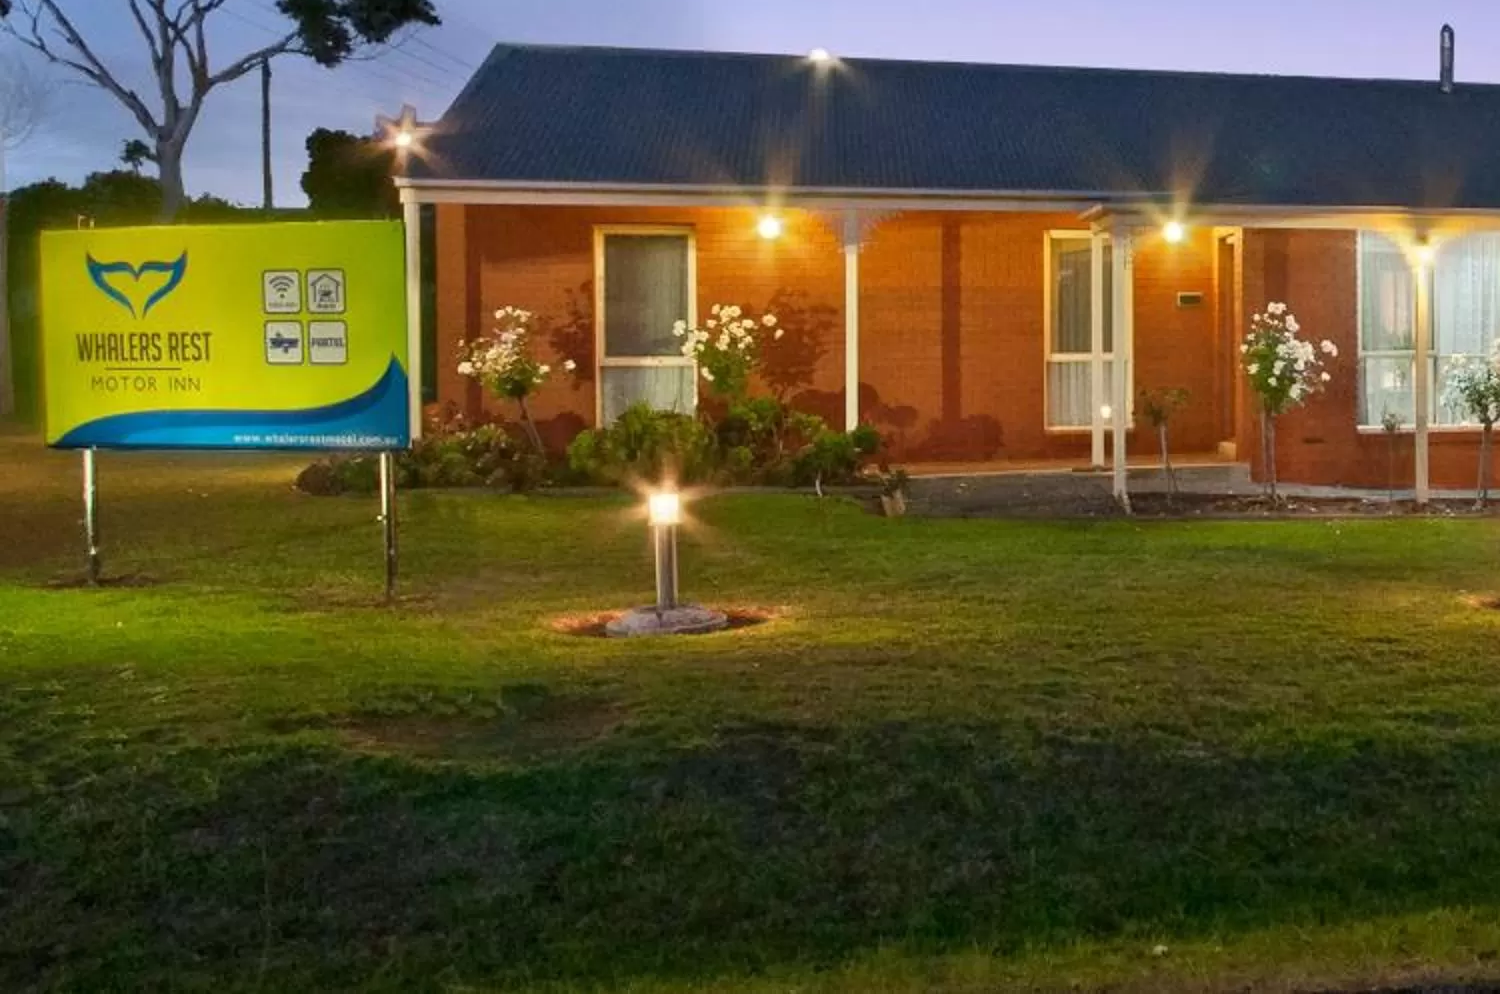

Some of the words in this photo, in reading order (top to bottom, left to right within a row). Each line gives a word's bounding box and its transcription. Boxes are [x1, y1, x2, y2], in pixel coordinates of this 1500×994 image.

[76, 333, 162, 362] WHALERS
[168, 332, 212, 362] REST
[91, 375, 158, 392] MOTOR
[168, 375, 201, 391] INN
